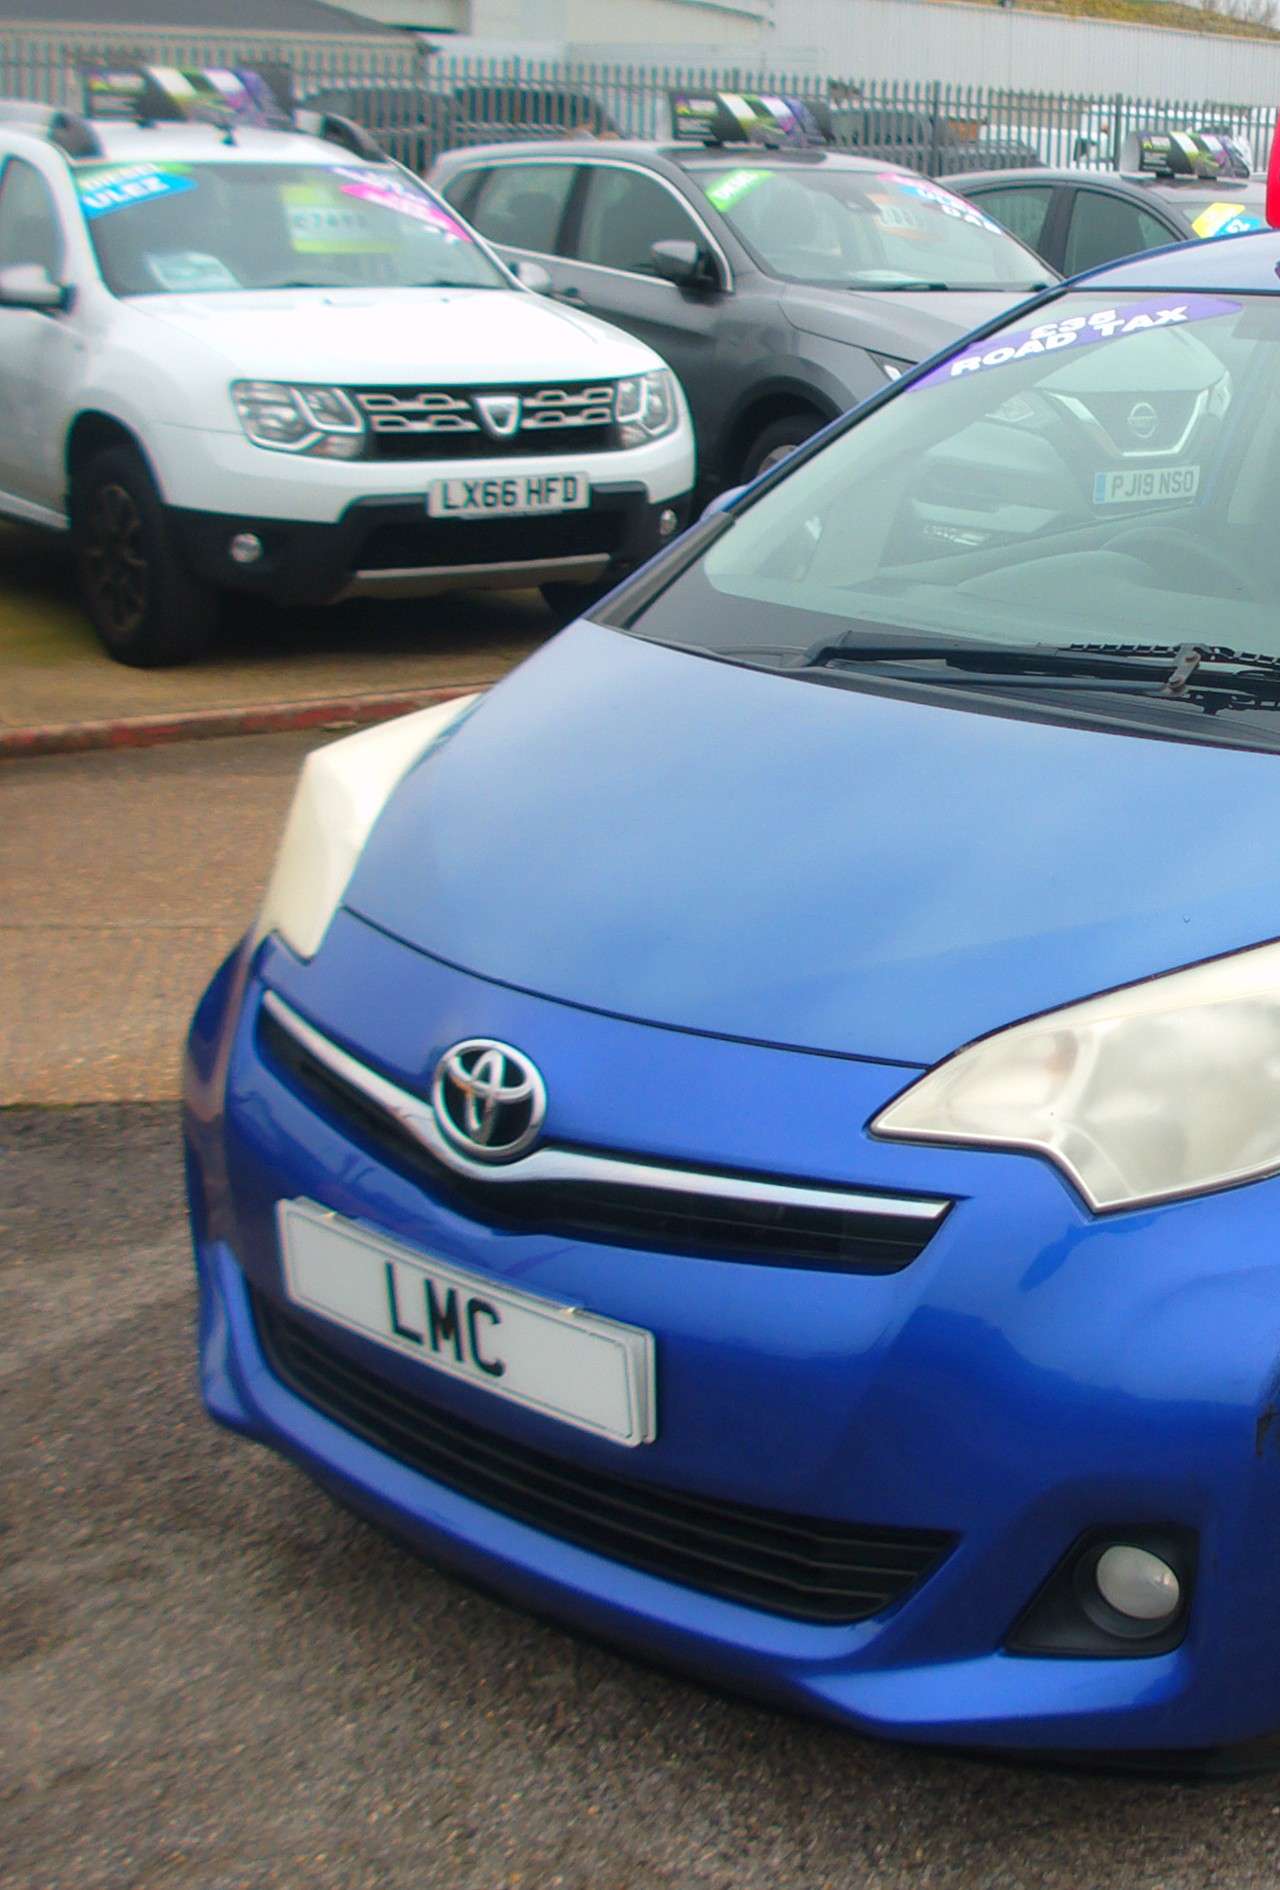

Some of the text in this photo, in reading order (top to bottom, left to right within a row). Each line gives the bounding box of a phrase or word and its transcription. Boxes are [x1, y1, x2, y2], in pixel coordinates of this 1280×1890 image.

[951, 306, 1189, 376] ROAD TAX
[443, 475, 577, 510] LX66 HFD
[1110, 472, 1154, 499] PJ19
[384, 1261, 506, 1379] LMC
